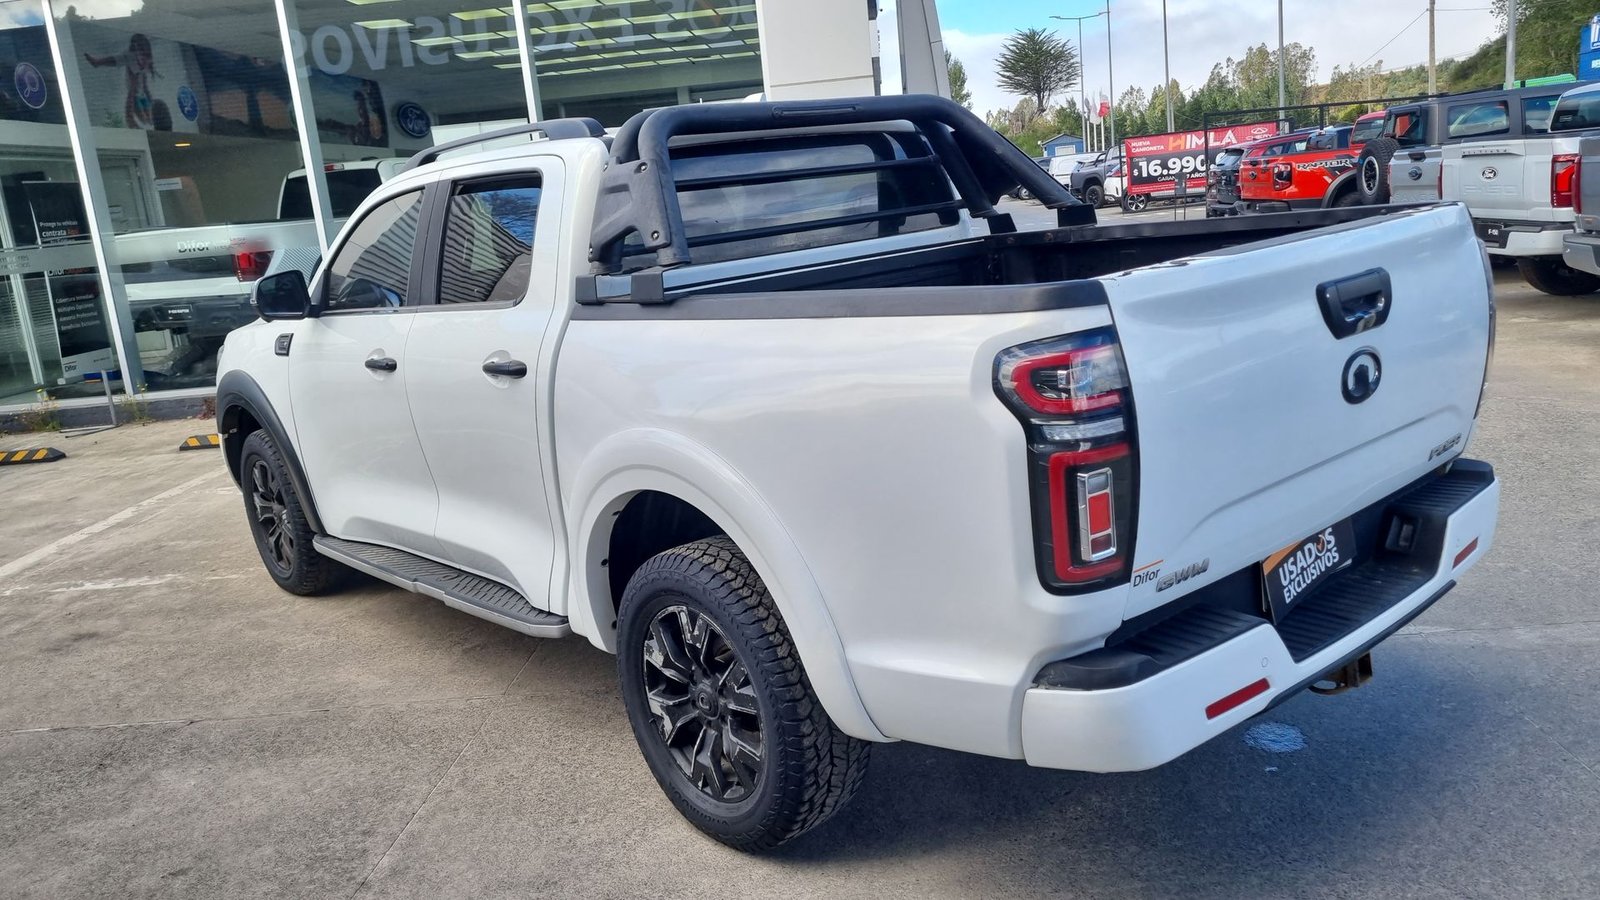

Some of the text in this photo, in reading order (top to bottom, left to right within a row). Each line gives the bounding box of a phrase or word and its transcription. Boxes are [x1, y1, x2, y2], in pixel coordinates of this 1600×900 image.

[1131, 145, 1165, 153] CAMIONETA
[1168, 129, 1238, 151] HIMLA
[1296, 159, 1353, 171] RAPTOR
[177, 240, 209, 253] Difor
[1279, 527, 1335, 587] USADOS
[1133, 568, 1161, 588] Difor
[1156, 557, 1210, 593] GWM
[1283, 547, 1339, 604] EXCLUSIVOS
